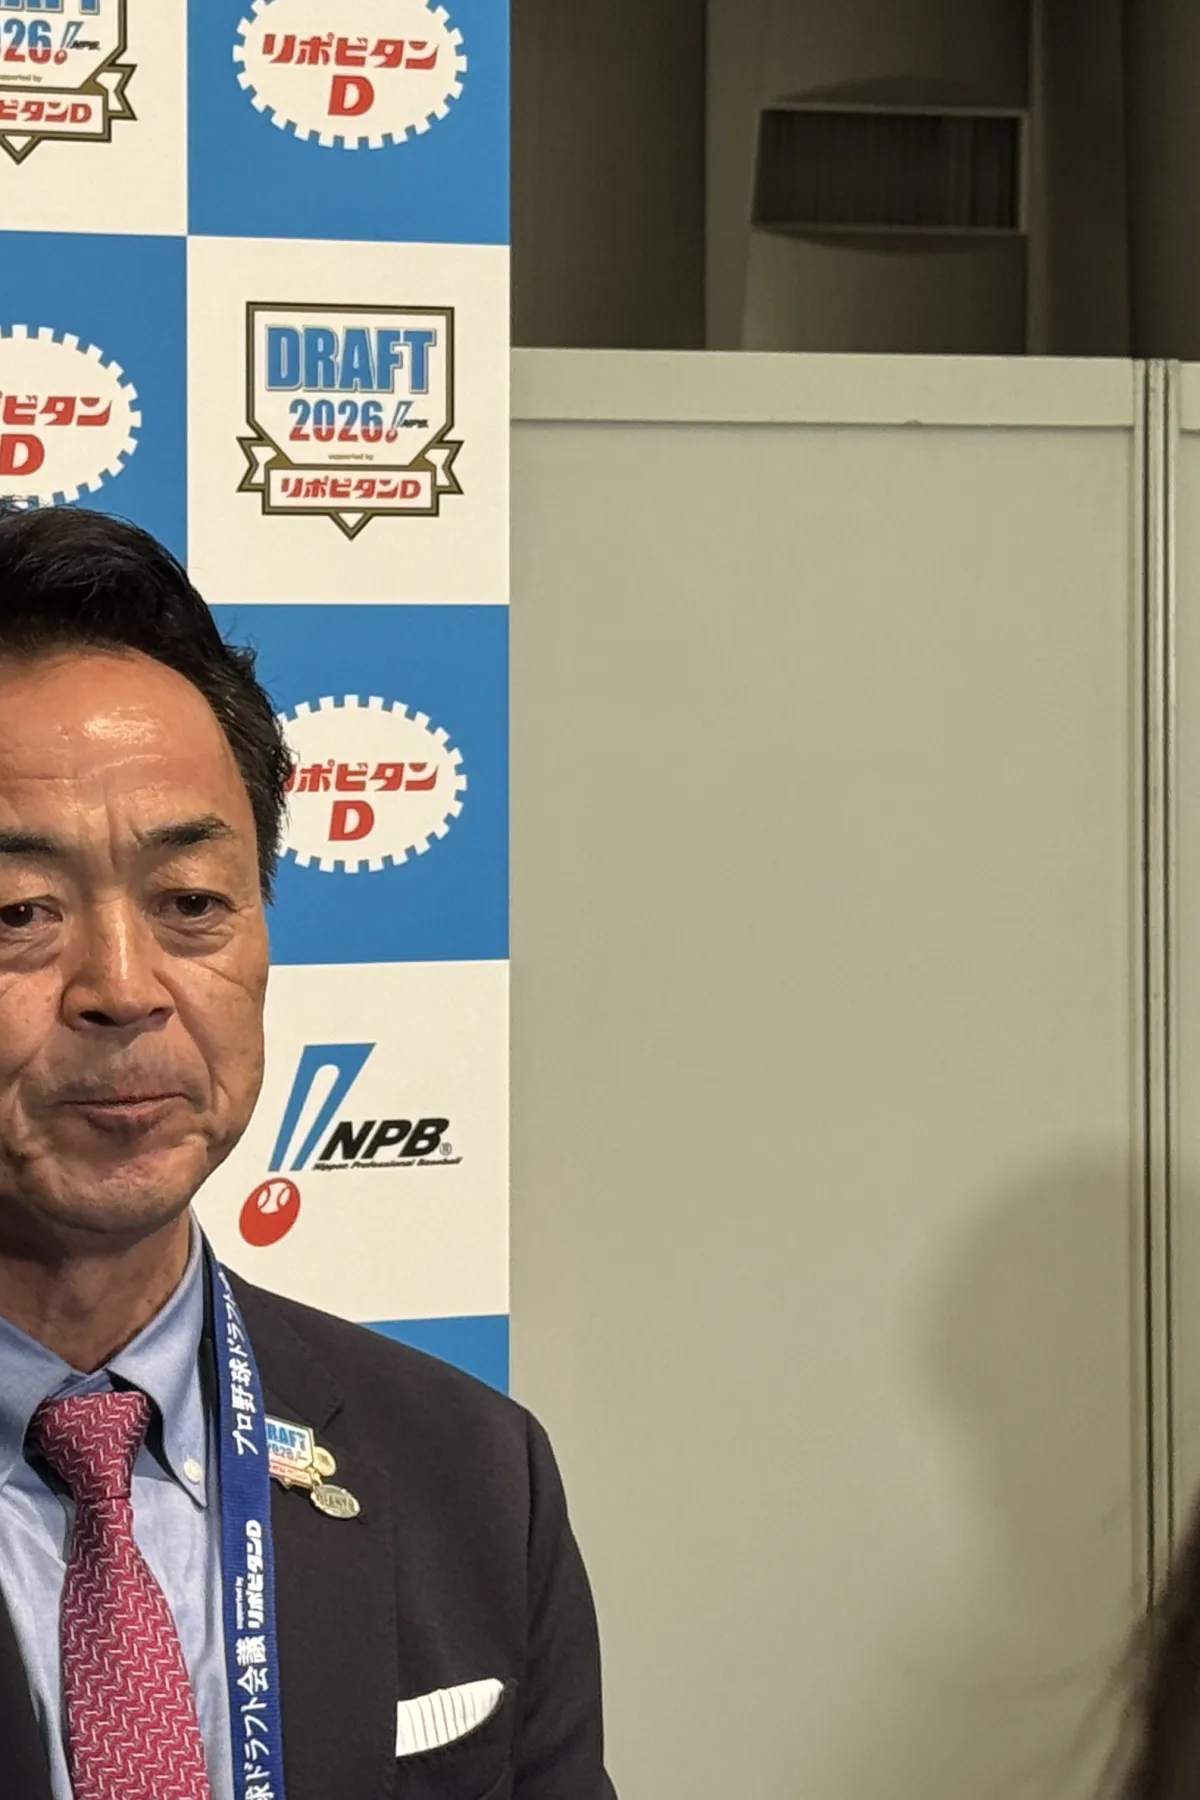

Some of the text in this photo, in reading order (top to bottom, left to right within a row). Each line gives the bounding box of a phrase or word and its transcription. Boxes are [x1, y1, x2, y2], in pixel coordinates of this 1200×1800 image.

[262, 31, 439, 71] リポビタン
[327, 74, 375, 117] D
[265, 323, 437, 394] DRAFT
[280, 475, 422, 500] リポビタンD
[328, 799, 376, 842] D
[267, 1423, 306, 1452] RAFT
